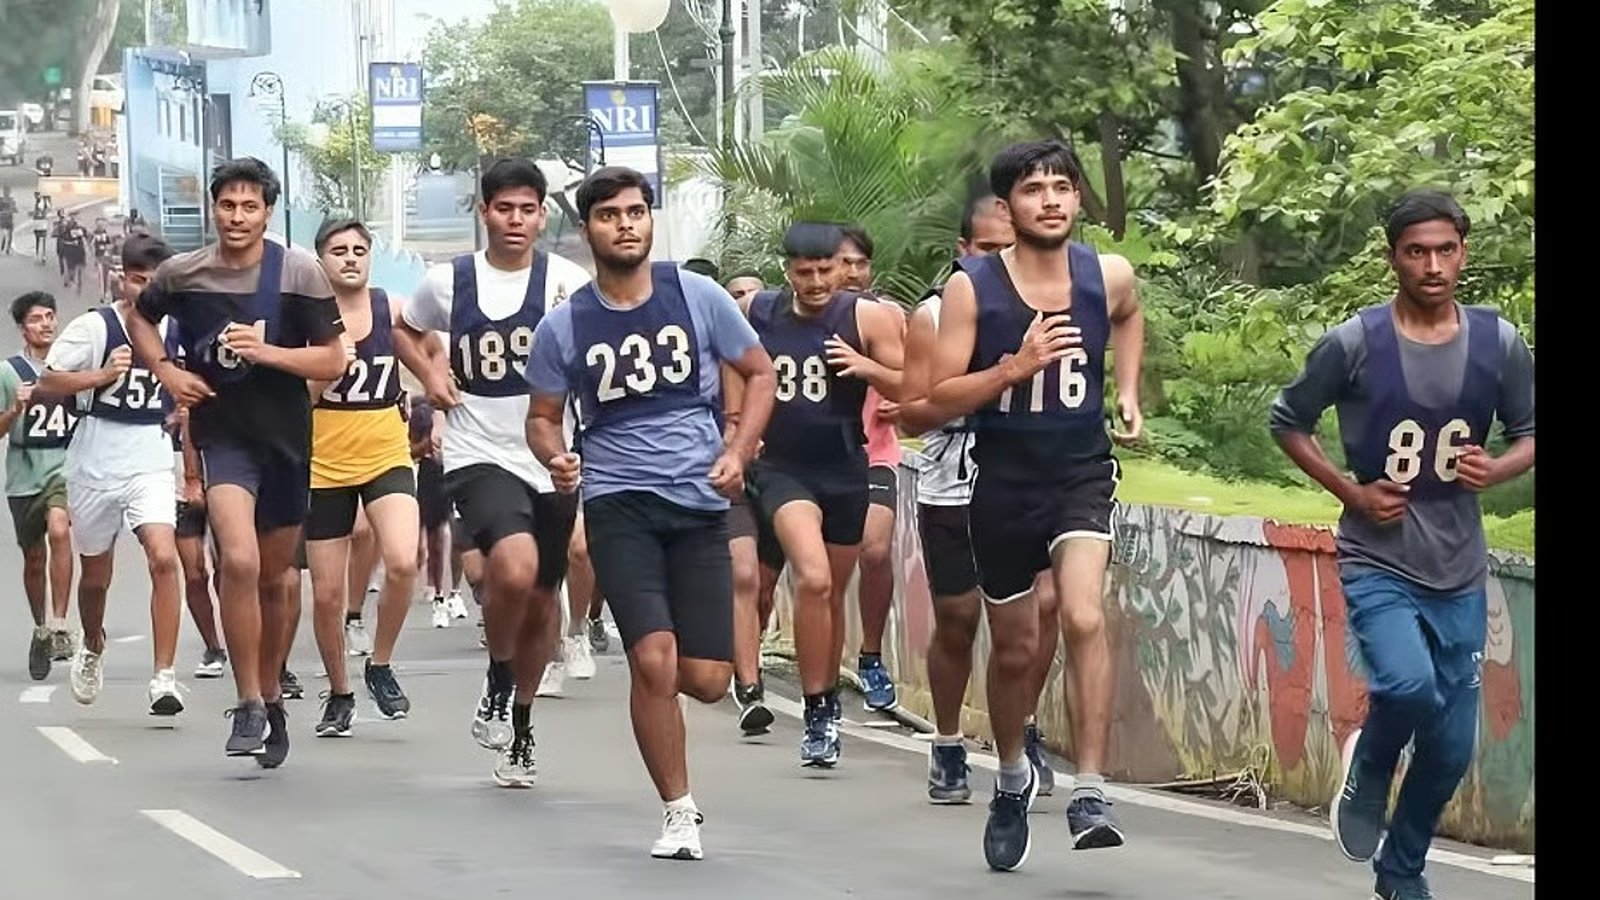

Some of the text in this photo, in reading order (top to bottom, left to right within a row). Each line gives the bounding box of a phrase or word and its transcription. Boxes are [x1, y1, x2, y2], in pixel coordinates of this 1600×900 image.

[375, 77, 417, 98] NRI
[590, 105, 651, 132] NRI
[459, 326, 534, 380] 189
[586, 325, 692, 402] 233
[1385, 419, 1470, 483] 86
